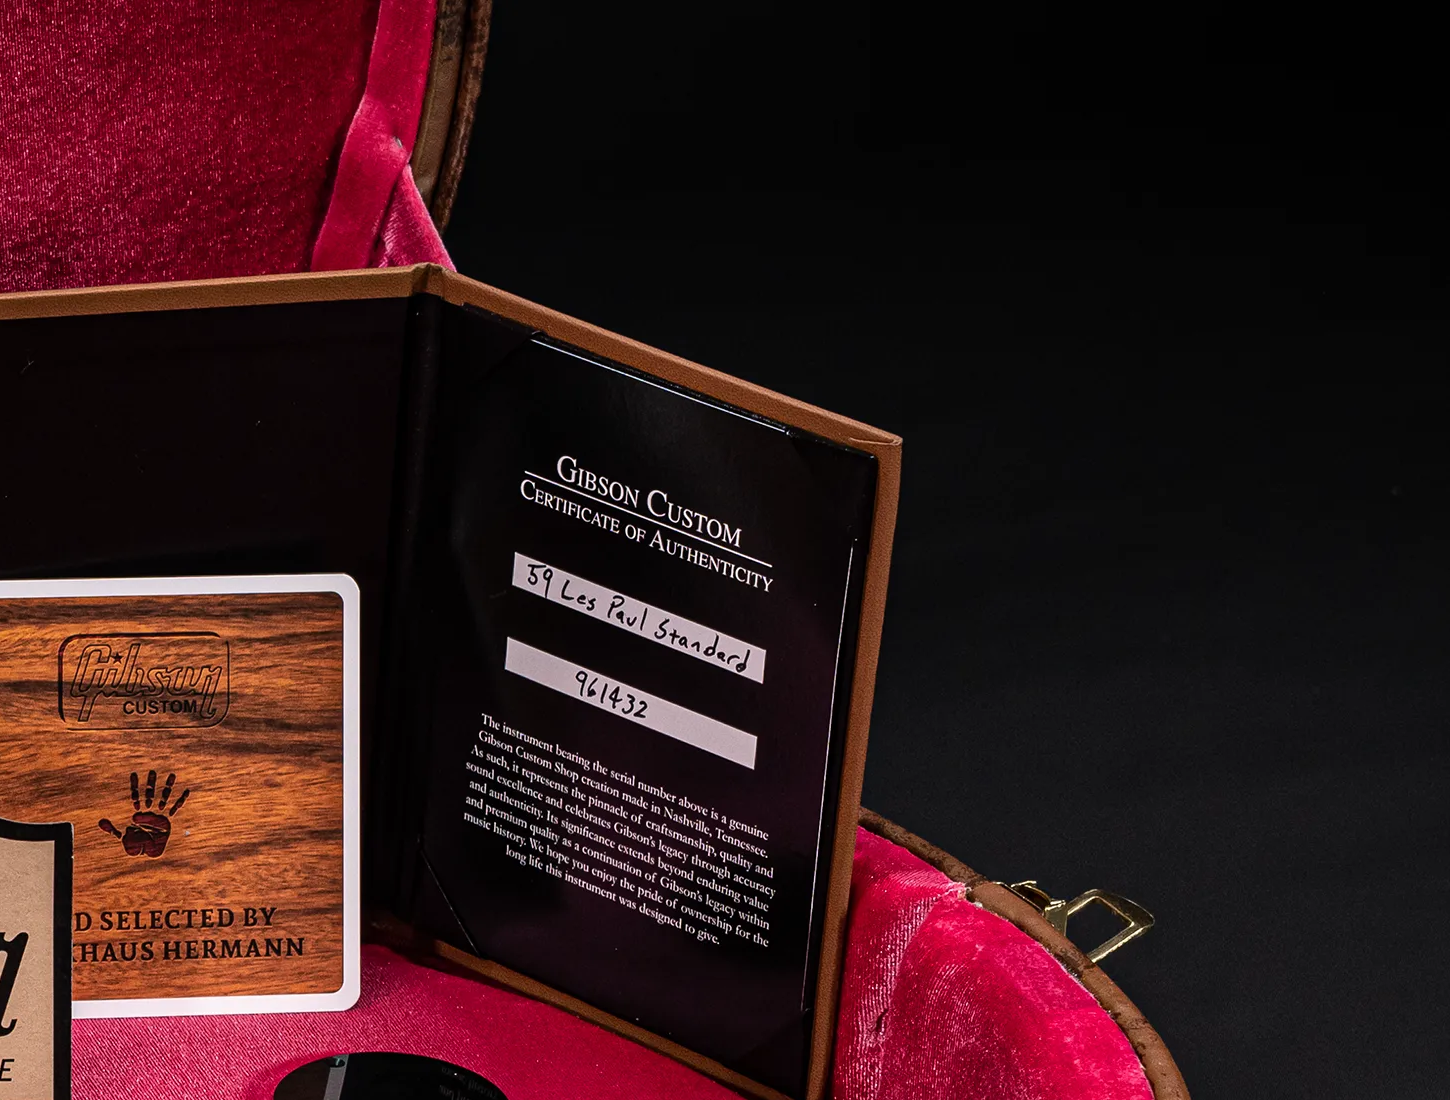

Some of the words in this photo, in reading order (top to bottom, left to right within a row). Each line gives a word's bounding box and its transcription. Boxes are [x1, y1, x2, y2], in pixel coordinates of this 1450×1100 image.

[519, 479, 621, 534] CERTIFICATE
[624, 523, 647, 543] OF
[648, 530, 774, 593] AUTHENTICITY
[557, 455, 640, 508] GIBSON
[646, 489, 743, 548] CUSTOM
[526, 563, 553, 599] 59
[560, 579, 597, 611] Les
[606, 594, 649, 631] Paul
[653, 617, 751, 673] Standard
[70, 643, 223, 722] Gibson
[123, 700, 198, 715] CUSTOM
[574, 670, 649, 719] 961432
[466, 762, 495, 780] sound
[497, 775, 543, 801] excellence
[545, 795, 563, 809] and
[565, 804, 611, 829] celebrates
[614, 822, 656, 848] Gibson's
[659, 840, 688, 863] legacy
[691, 856, 730, 879] through
[733, 874, 776, 899] accuracy
[471, 745, 484, 758] As
[486, 754, 510, 771] such,
[522, 770, 568, 794] represents
[571, 787, 586, 801] the
[588, 796, 628, 819] pinnacle
[645, 819, 717, 857] craftsmanship,
[720, 851, 752, 872] quality
[755, 864, 774, 879] and
[479, 730, 513, 753] Gibson
[516, 746, 552, 770] Custom
[554, 762, 579, 783] Shop
[582, 776, 619, 798] creation
[622, 791, 649, 809] made
[664, 806, 713, 838] Nashville,
[715, 827, 768, 858] Tennessee.
[481, 713, 500, 730] The
[503, 722, 553, 753] instrument
[555, 744, 591, 771] bearing
[593, 761, 608, 775] the
[610, 772, 635, 787] serial
[638, 781, 676, 803] number
[678, 797, 708, 816] above
[729, 819, 769, 841] genuine
[464, 812, 491, 830] music
[494, 822, 527, 847] history.
[529, 838, 544, 853] We
[547, 845, 570, 864] hope
[571, 860, 589, 873] you
[592, 867, 617, 886] enjoy
[620, 877, 636, 892] the
[638, 886, 663, 904] pride
[681, 905, 732, 934] ownership
[735, 925, 751, 939] for
[753, 932, 769, 948] the
[466, 796, 483, 810] and
[485, 804, 527, 829] premium
[530, 824, 560, 845] quality
[582, 845, 642, 878] continuation
[660, 877, 703, 902] Gibson's
[705, 894, 736, 918] legacy
[738, 910, 770, 930] within
[469, 781, 487, 794] and
[489, 788, 544, 820] authenticity.
[547, 810, 558, 824] Its
[561, 819, 615, 848] significance
[618, 844, 655, 864] extends
[658, 857, 694, 881] beyond
[696, 876, 741, 903] enduring
[743, 896, 769, 912] value
[506, 845, 526, 866] long
[529, 854, 543, 870] life
[545, 864, 562, 878] this
[564, 871, 616, 901] instrument
[618, 895, 637, 909] was
[639, 903, 682, 929] designed
[697, 929, 720, 945] give.
[100, 908, 235, 931] SELECTED
[243, 906, 278, 927] BY
[163, 937, 304, 960] HERMANN
